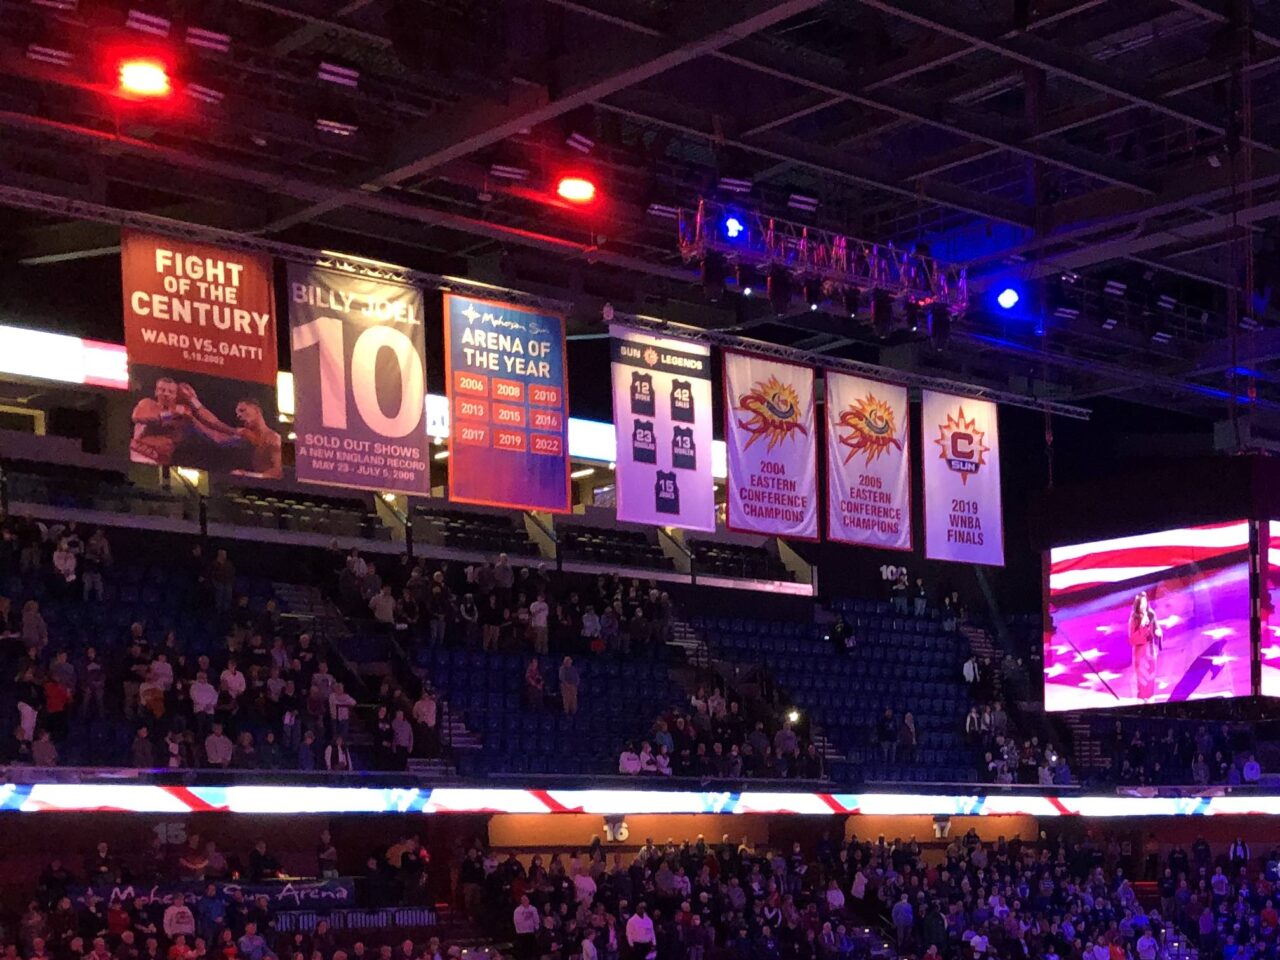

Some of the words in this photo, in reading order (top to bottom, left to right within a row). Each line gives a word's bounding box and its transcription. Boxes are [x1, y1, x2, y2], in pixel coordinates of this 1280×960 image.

[155, 249, 243, 287] FIGHT
[163, 276, 191, 295] OF
[196, 282, 238, 305] THE
[292, 282, 352, 313] BILLY
[361, 298, 421, 325] JOEL
[131, 291, 270, 336] CENTURY
[141, 328, 189, 348] WARD
[193, 337, 217, 353] VS.
[219, 342, 263, 360] GATTI
[461, 327, 524, 354] ARENA
[527, 340, 551, 358] OF
[463, 348, 499, 371] THE
[503, 355, 551, 379] YEAR
[620, 346, 641, 359] SUN
[661, 354, 703, 370] LEGENDS
[293, 317, 424, 438] 10
[460, 377, 484, 391] 2006
[497, 384, 521, 398] 2008
[534, 390, 557, 402] 2010
[634, 381, 650, 394] 12
[674, 388, 690, 401] 42
[461, 402, 484, 416] 2013
[498, 409, 521, 422] 2015
[535, 414, 558, 426] 2016
[461, 428, 484, 441] 2017
[499, 434, 522, 446] 2019
[636, 429, 652, 443] 23
[675, 436, 691, 449] 13
[305, 434, 340, 449] SOLD
[343, 439, 371, 453] OUT
[374, 443, 420, 459] SHOWS
[535, 439, 559, 451] 2022
[951, 431, 975, 460] C
[299, 447, 307, 456] A
[309, 448, 334, 459] NEW
[336, 451, 385, 466] ENGLAND
[386, 458, 426, 471] RECORD
[951, 460, 976, 472] SUN
[312, 460, 335, 471] MAY
[356, 465, 380, 476] JULY
[760, 461, 786, 476] 2004
[750, 474, 796, 492] EASTERN
[740, 487, 807, 508] CONFERENCE
[850, 487, 892, 505] EASTERN
[743, 503, 805, 523] CHAMPIONS
[840, 501, 901, 520] CONFERENCE
[952, 499, 978, 515] 2019
[843, 515, 899, 534] CHAMPIONS
[949, 514, 982, 531] WNBA
[947, 529, 984, 546] FINALS
[603, 822, 629, 841] 16
[933, 821, 952, 838] 17
[276, 882, 349, 906] Arena
